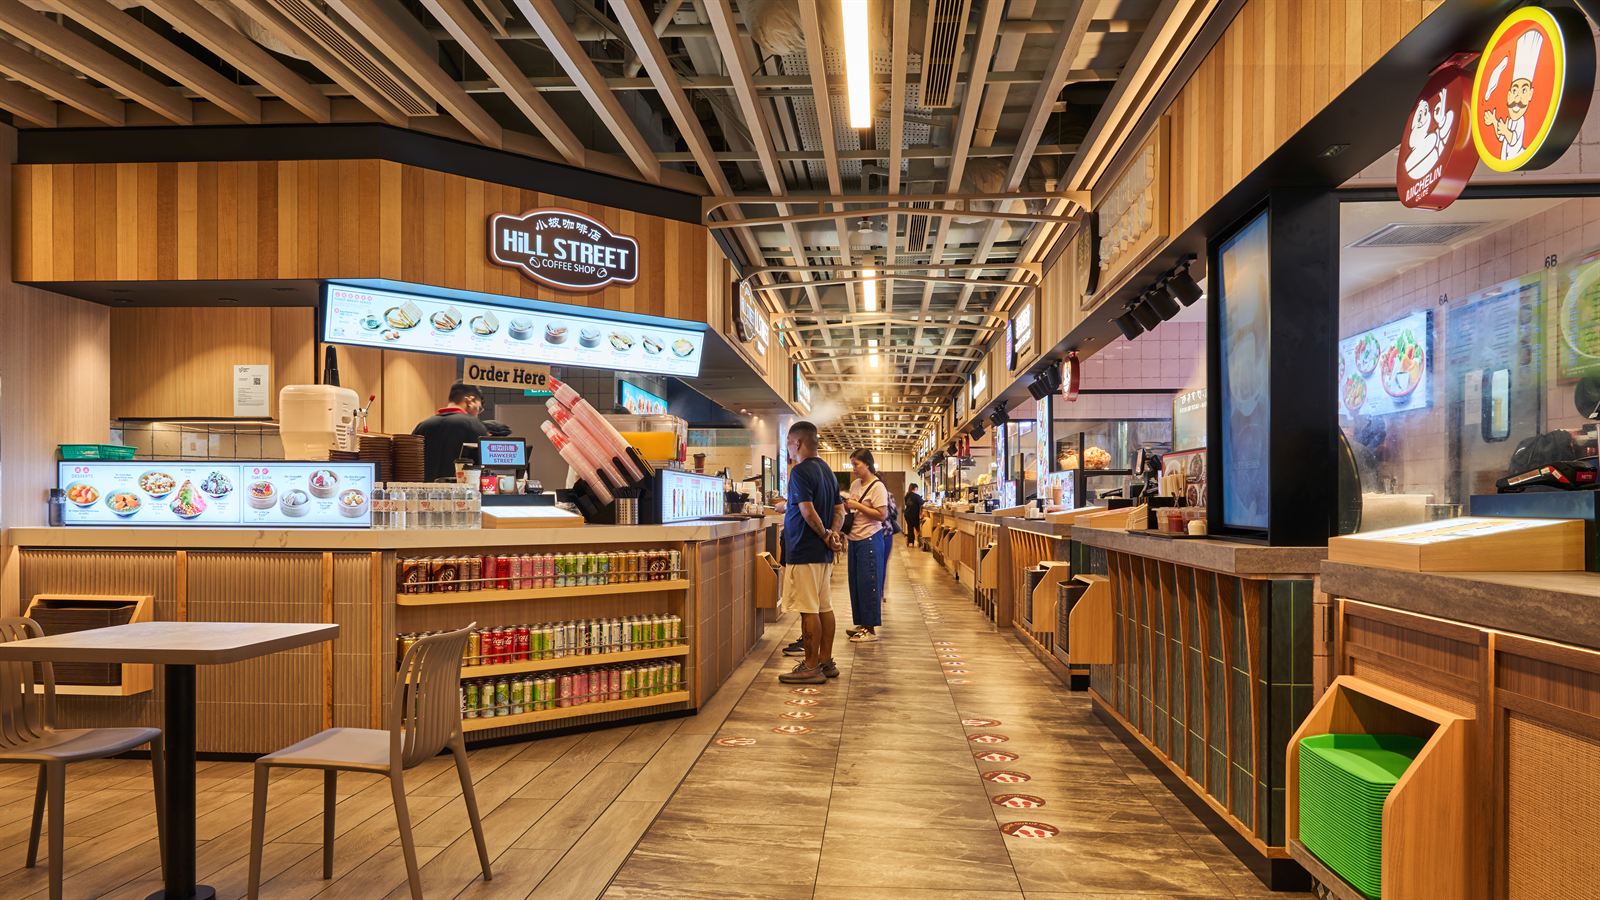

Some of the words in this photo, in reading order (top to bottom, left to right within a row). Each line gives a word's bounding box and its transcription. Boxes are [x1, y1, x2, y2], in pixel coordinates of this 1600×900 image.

[1406, 165, 1442, 202] MICHELIN
[535, 217, 602, 242] 小坡咖啡店
[553, 238, 629, 270] STREET
[1545, 254, 1557, 268] 6B
[541, 258, 573, 271] COFFEE
[573, 263, 596, 275] SHOP
[1438, 293, 1449, 305] 6A
[468, 364, 510, 383] Order
[512, 368, 546, 386] Here
